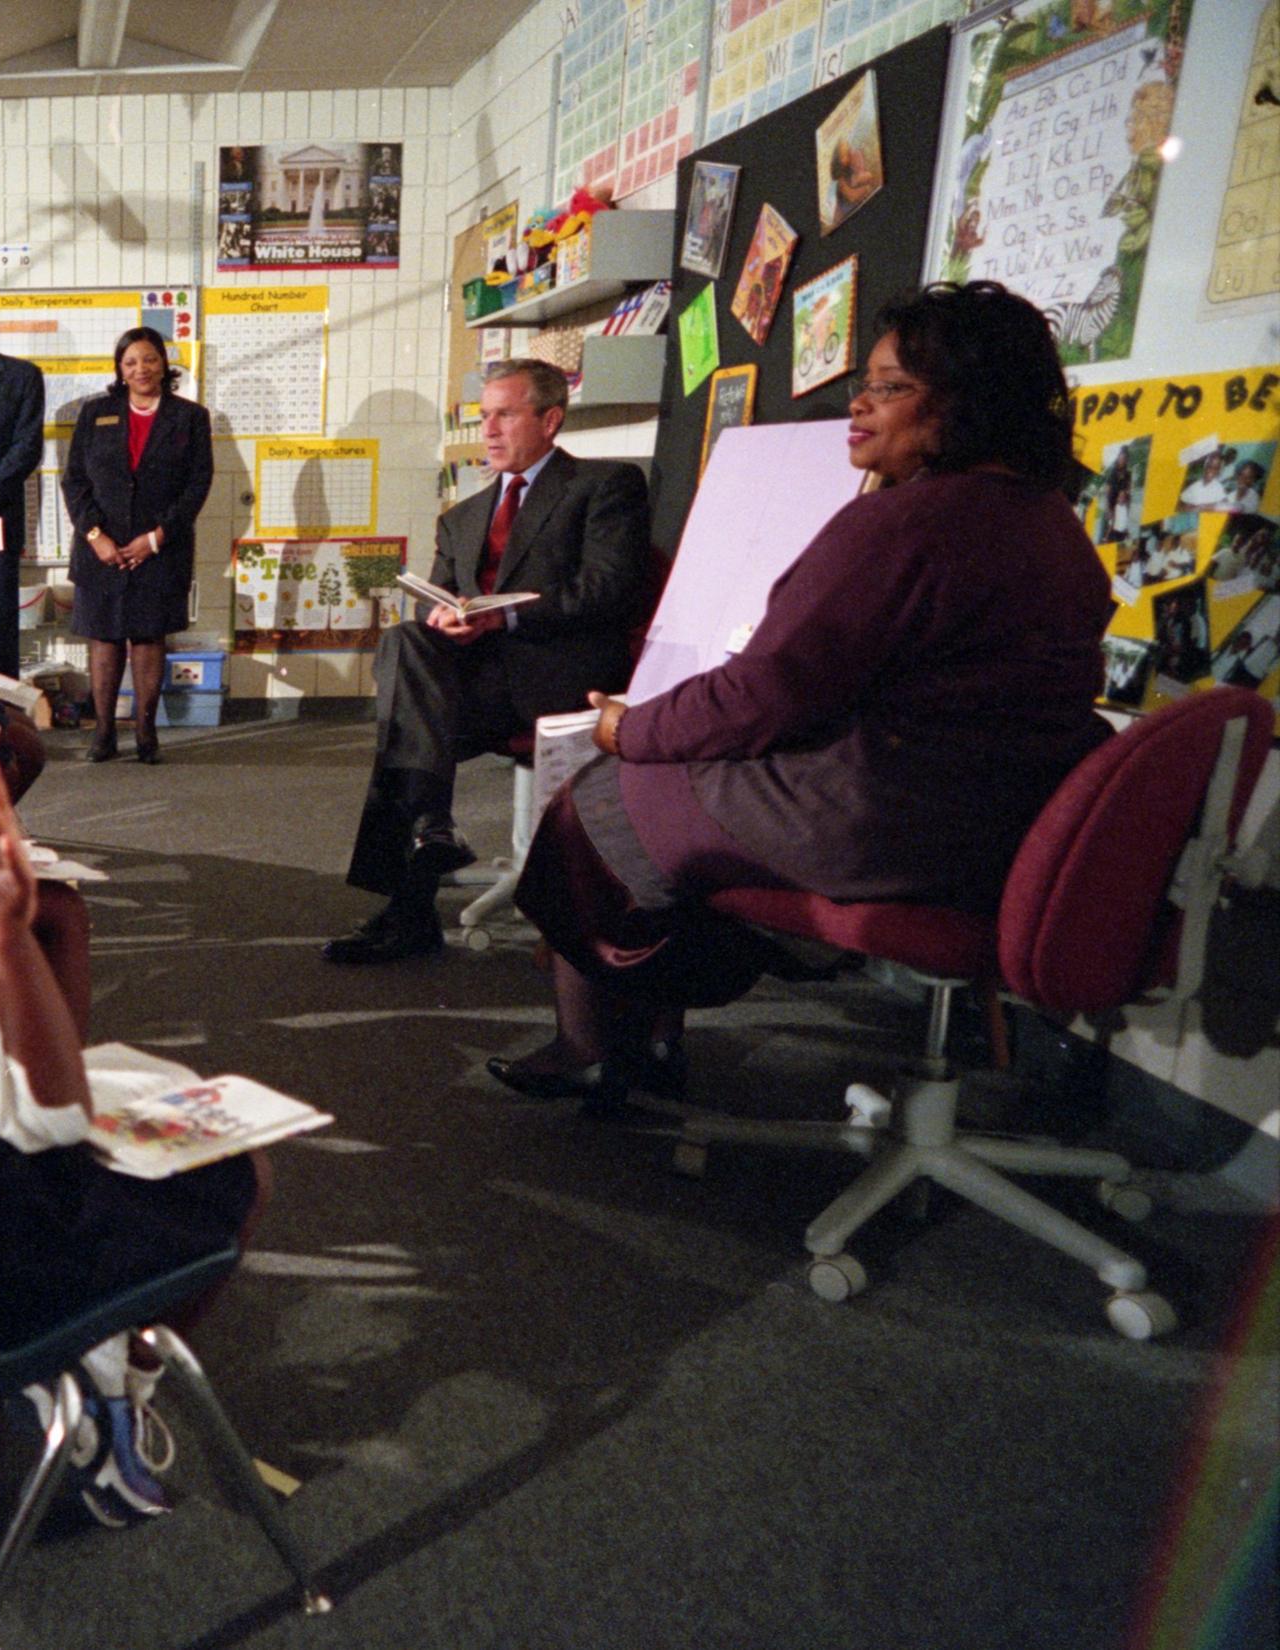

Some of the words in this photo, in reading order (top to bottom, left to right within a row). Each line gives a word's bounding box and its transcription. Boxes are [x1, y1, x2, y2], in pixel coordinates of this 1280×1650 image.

[1100, 52, 1130, 87] Dd
[1089, 92, 1118, 126] Hh
[1088, 164, 1115, 200] Pp
[254, 245, 305, 259] White
[308, 244, 362, 258] House
[0, 296, 25, 307] Daily
[28, 295, 94, 308] Temperatures
[221, 290, 264, 301] Hundred
[267, 289, 307, 301] Number
[250, 302, 279, 312] Chart
[1157, 381, 1203, 420] TO
[267, 447, 294, 458] Daily
[297, 446, 366, 456] Temperatures
[260, 557, 317, 581] Tree
